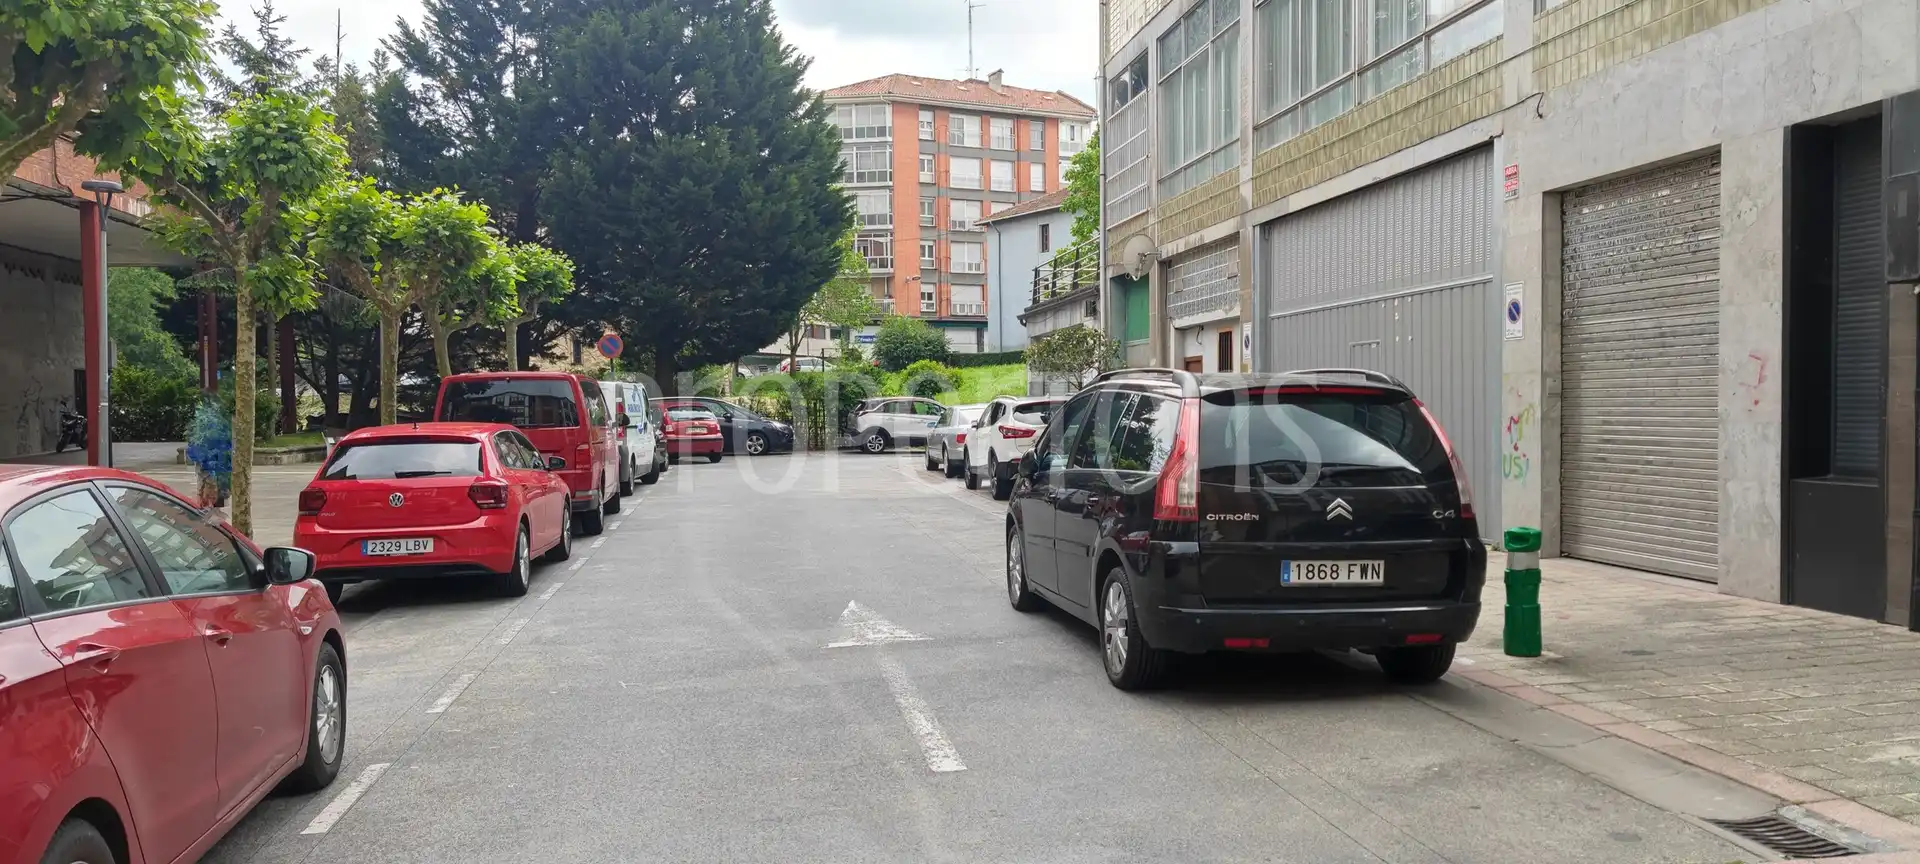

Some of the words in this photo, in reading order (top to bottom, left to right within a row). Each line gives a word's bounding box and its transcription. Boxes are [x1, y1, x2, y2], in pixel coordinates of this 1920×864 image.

[1206, 512, 1260, 521] CITROËN
[1432, 509, 1456, 519] C4
[370, 541, 402, 553] 2329
[405, 539, 429, 551] LBV
[1295, 563, 1340, 581] 1868
[1347, 563, 1382, 580] FWN
